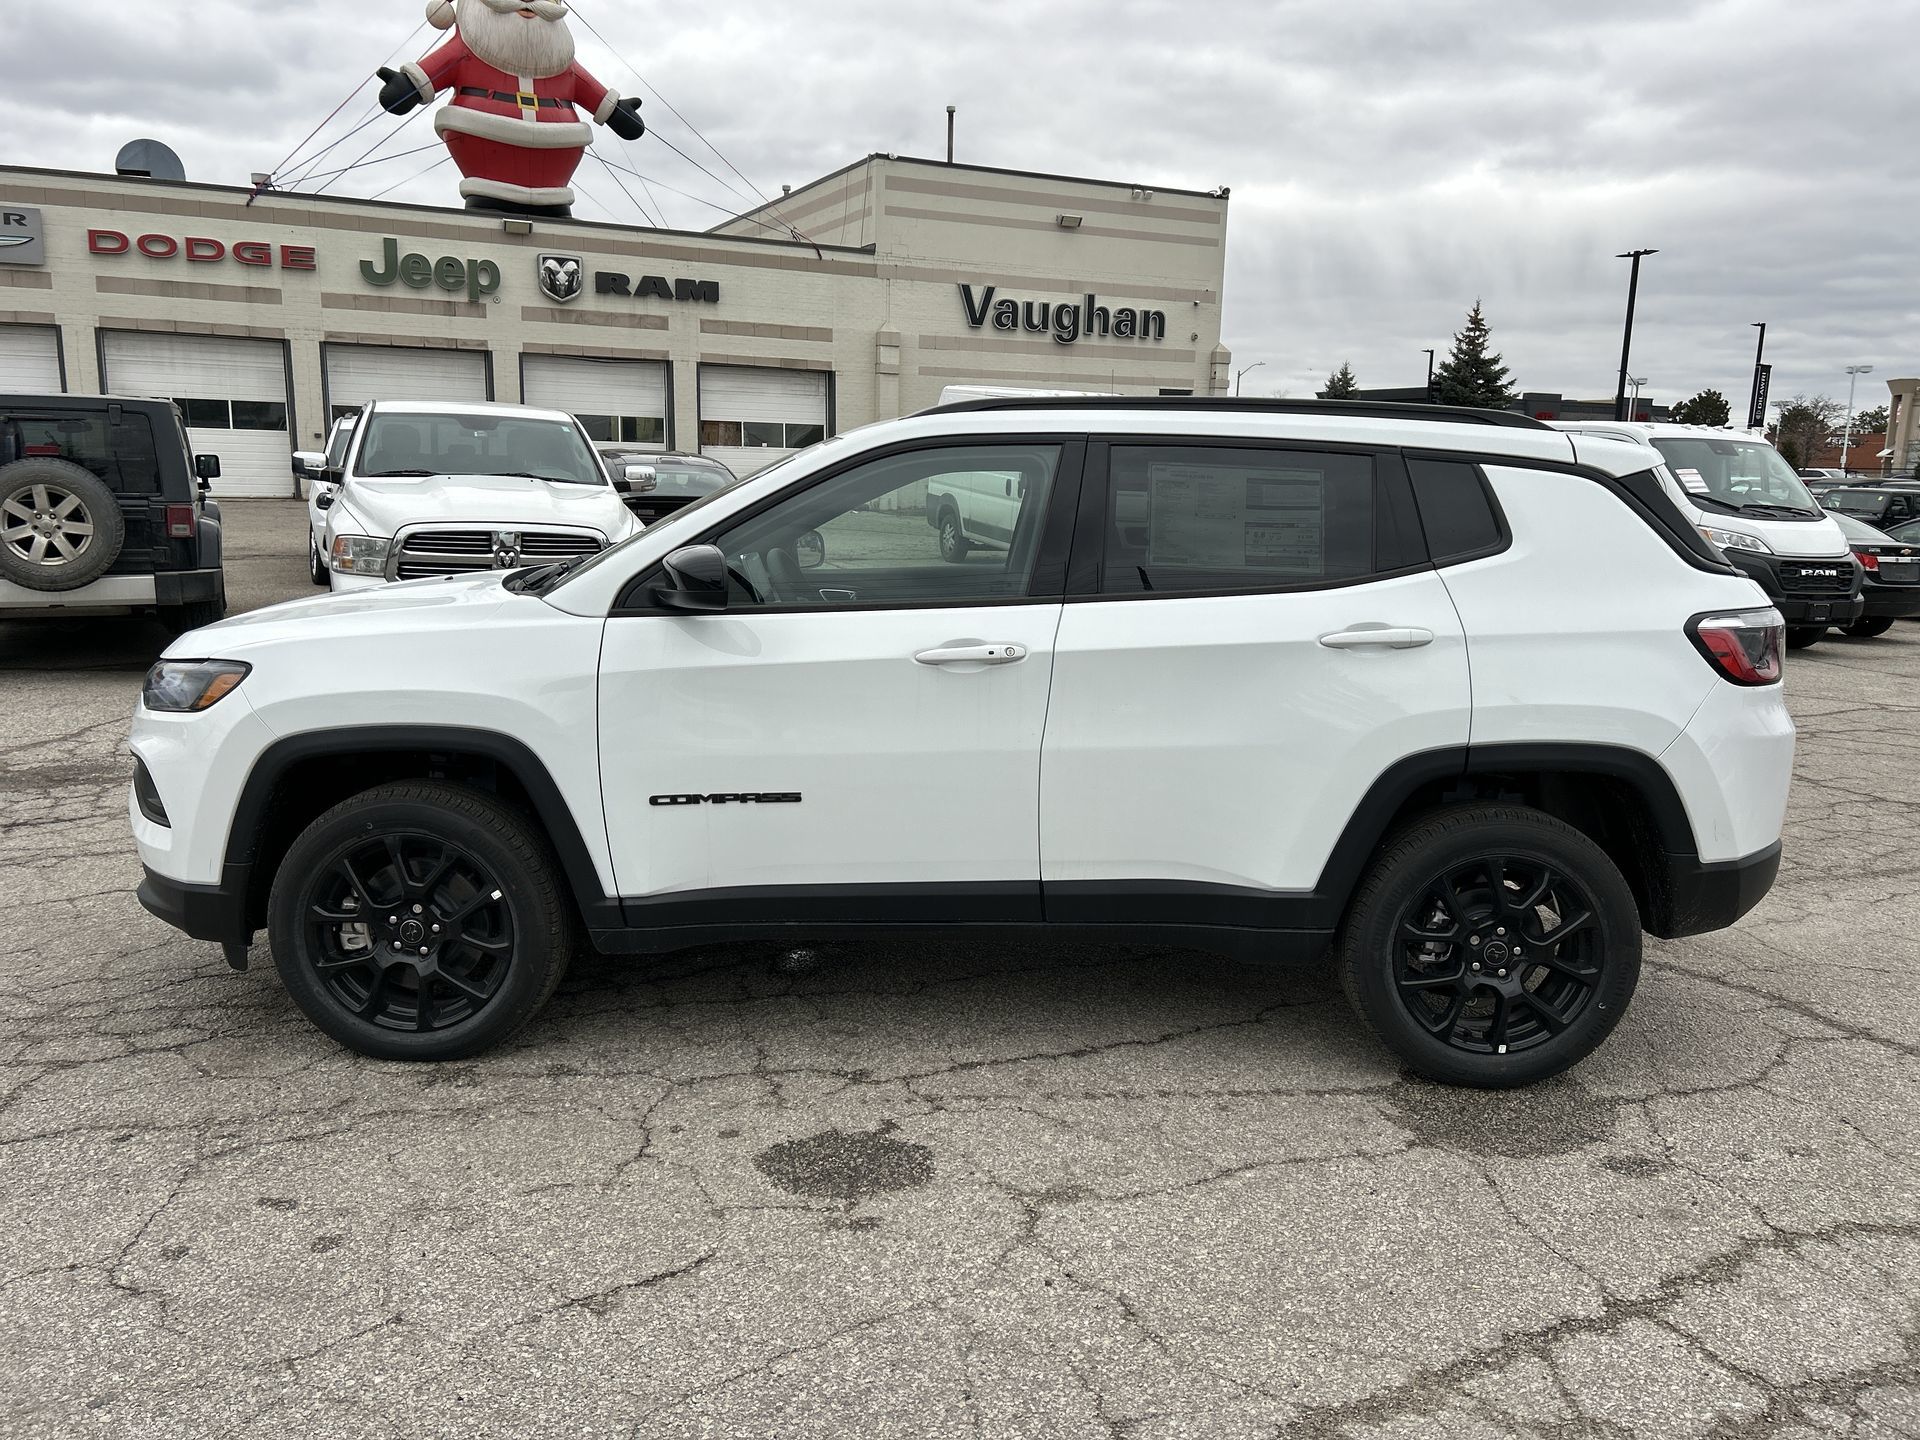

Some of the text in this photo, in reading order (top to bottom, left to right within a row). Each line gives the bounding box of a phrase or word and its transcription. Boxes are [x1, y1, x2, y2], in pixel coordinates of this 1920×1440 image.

[87, 228, 317, 271] DODGE
[359, 237, 501, 303] Jeep
[595, 271, 720, 302] RAM
[957, 283, 1166, 344] Vaughan
[649, 792, 802, 806] COMPASS
